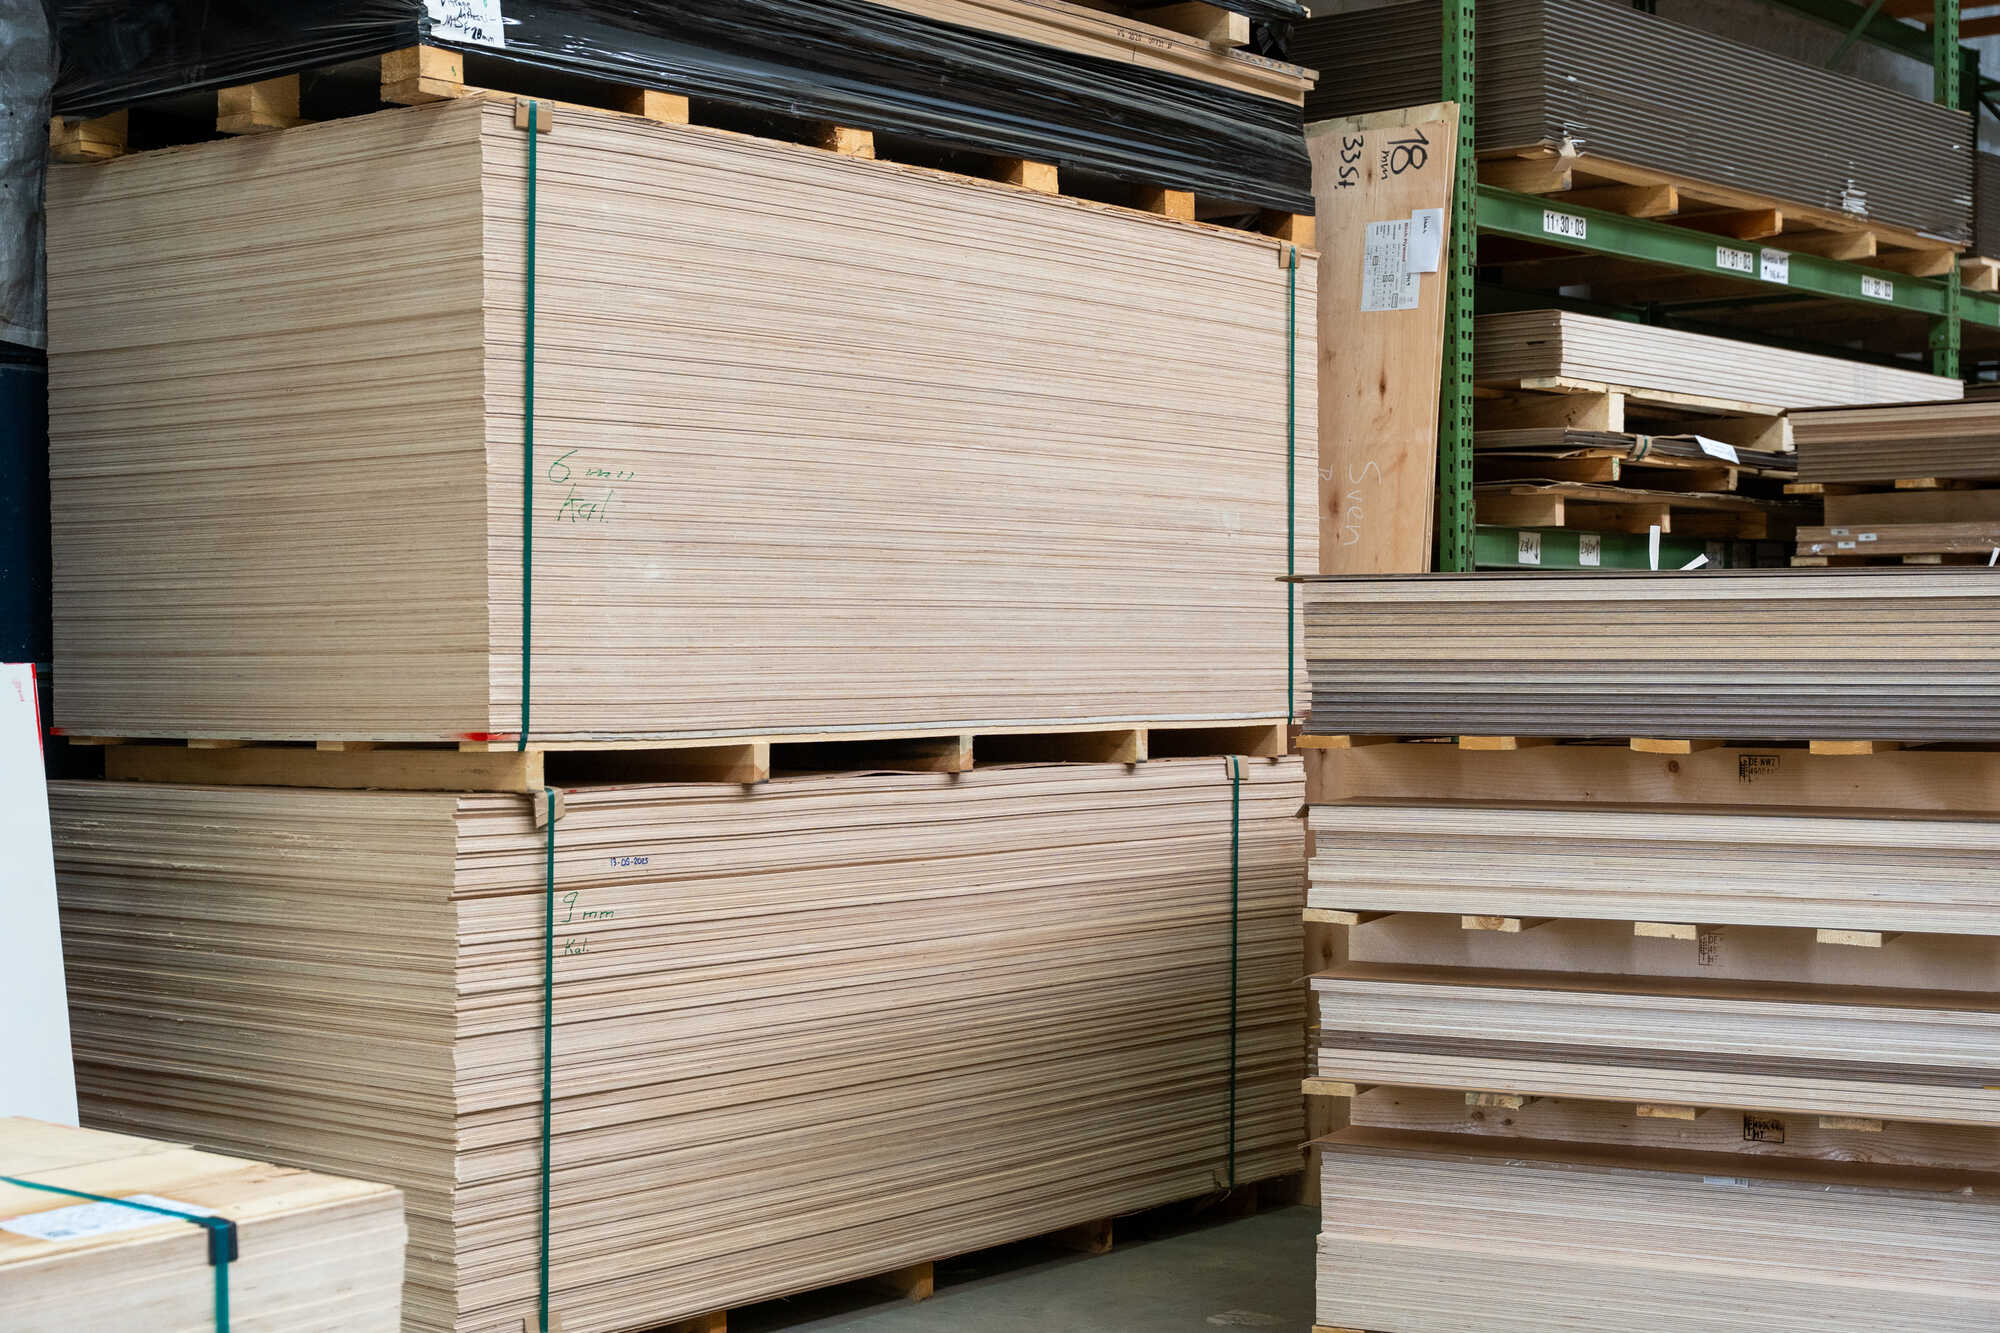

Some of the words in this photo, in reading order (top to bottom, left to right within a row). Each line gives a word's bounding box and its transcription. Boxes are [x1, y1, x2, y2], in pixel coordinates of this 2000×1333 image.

[1387, 127, 1430, 175] 18
[548, 448, 578, 484] 6
[1343, 460, 1383, 546] Sven
[560, 891, 580, 922] 9
[582, 910, 615, 921] mm
